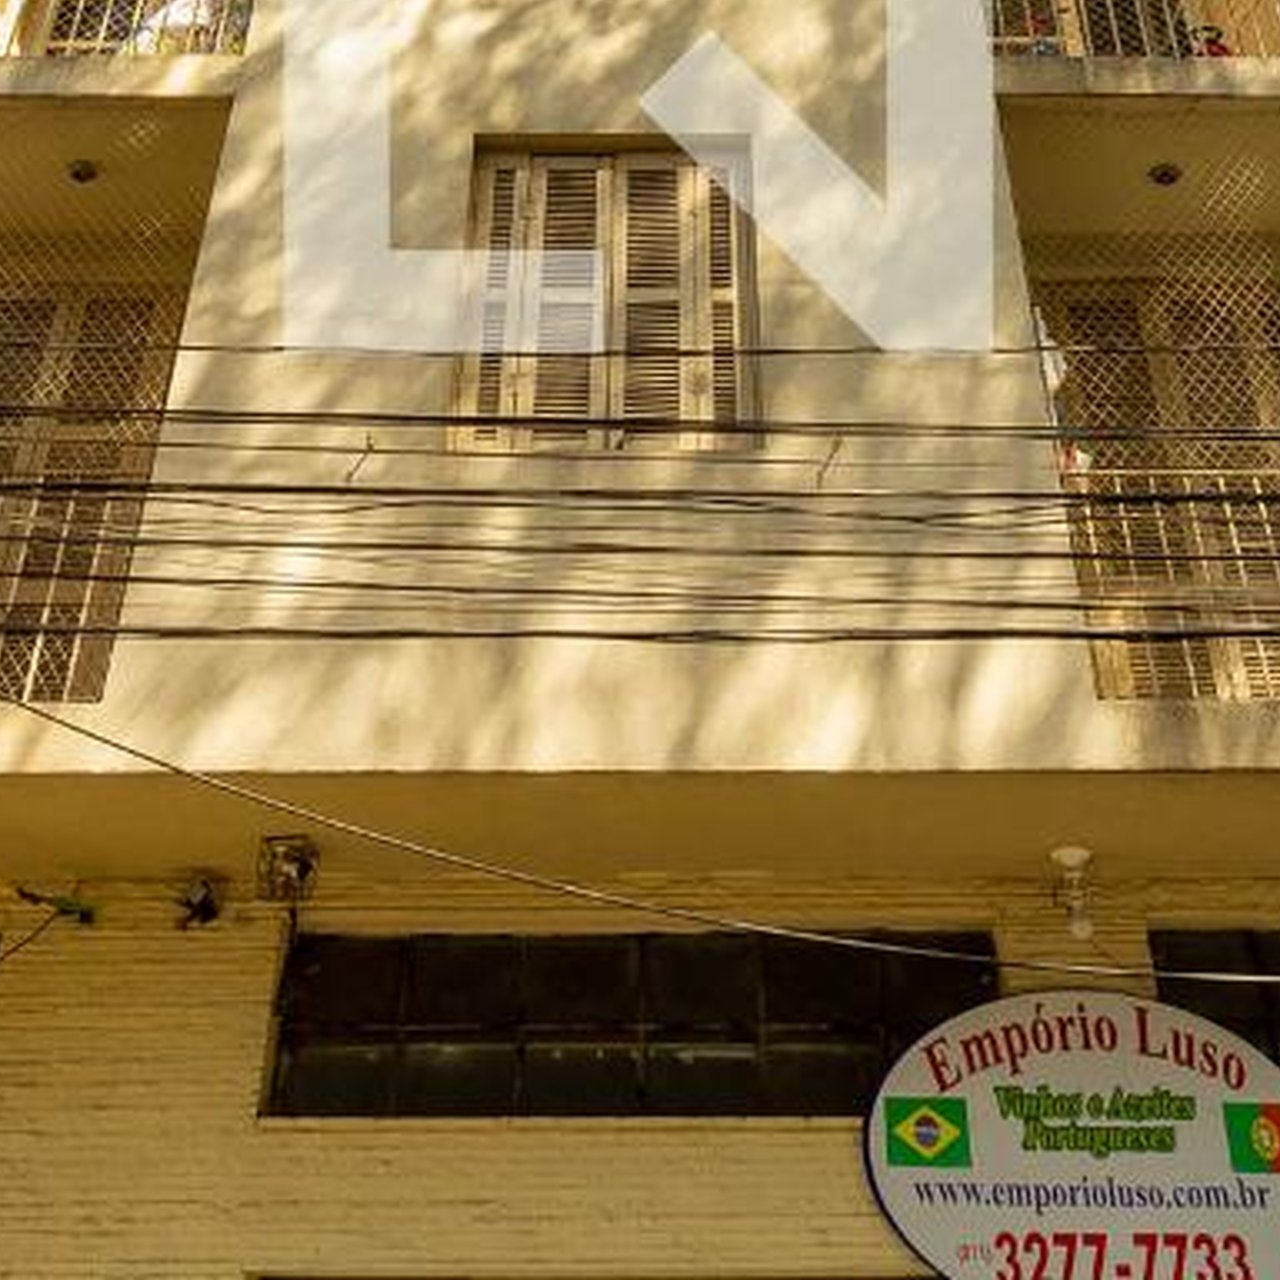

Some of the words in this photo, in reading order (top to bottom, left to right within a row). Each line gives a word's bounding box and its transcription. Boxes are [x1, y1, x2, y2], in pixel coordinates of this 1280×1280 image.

[923, 1001, 1119, 1093] Empório
[1134, 1005, 1247, 1091] Luso
[993, 1084, 1083, 1121] Vinhos
[1086, 1092, 1105, 1120] e
[1106, 1085, 1197, 1122] Azeites
[1022, 1116, 1177, 1158] Portugueses
[913, 1174, 1271, 1216] www.emporioluso.com.br
[994, 1231, 1253, 1280] 3277-7733
